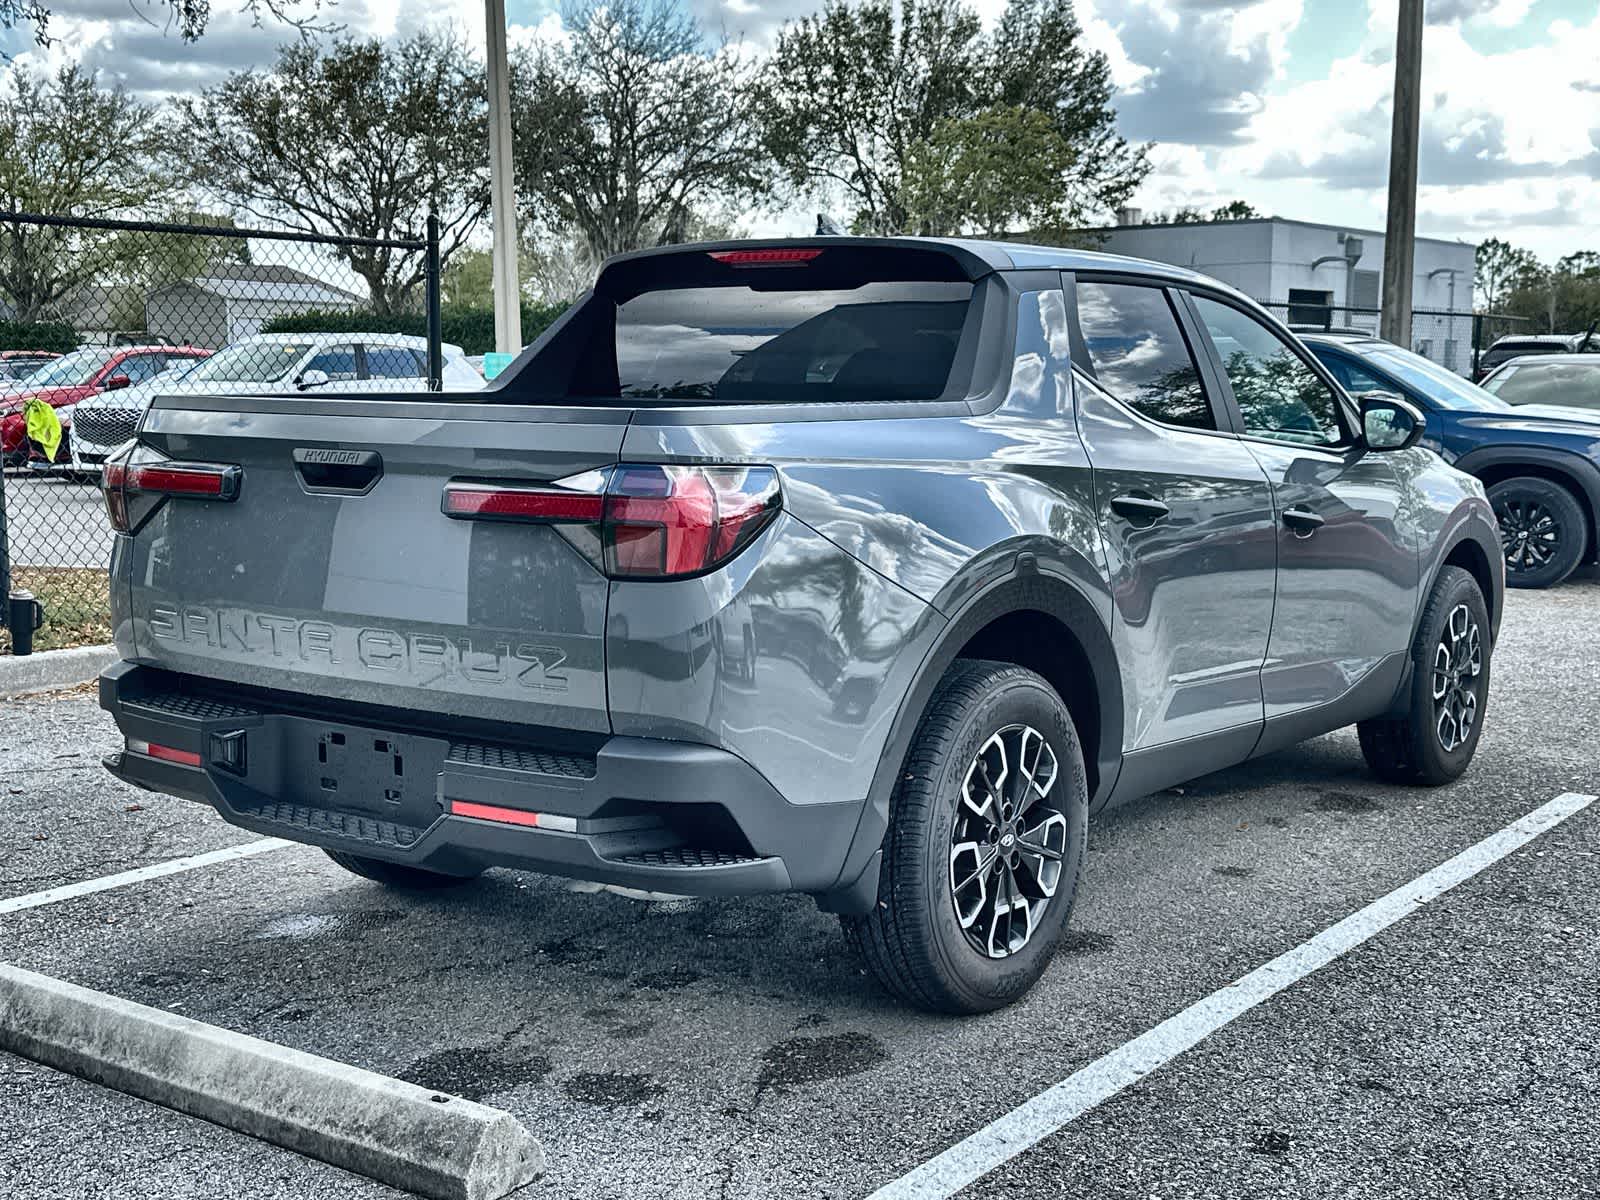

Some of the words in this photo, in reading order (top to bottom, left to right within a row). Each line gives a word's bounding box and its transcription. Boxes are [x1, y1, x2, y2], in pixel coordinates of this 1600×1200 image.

[303, 450, 361, 464] HYUNDAI
[149, 602, 342, 664] SANTA
[357, 628, 568, 692] CRUZ
